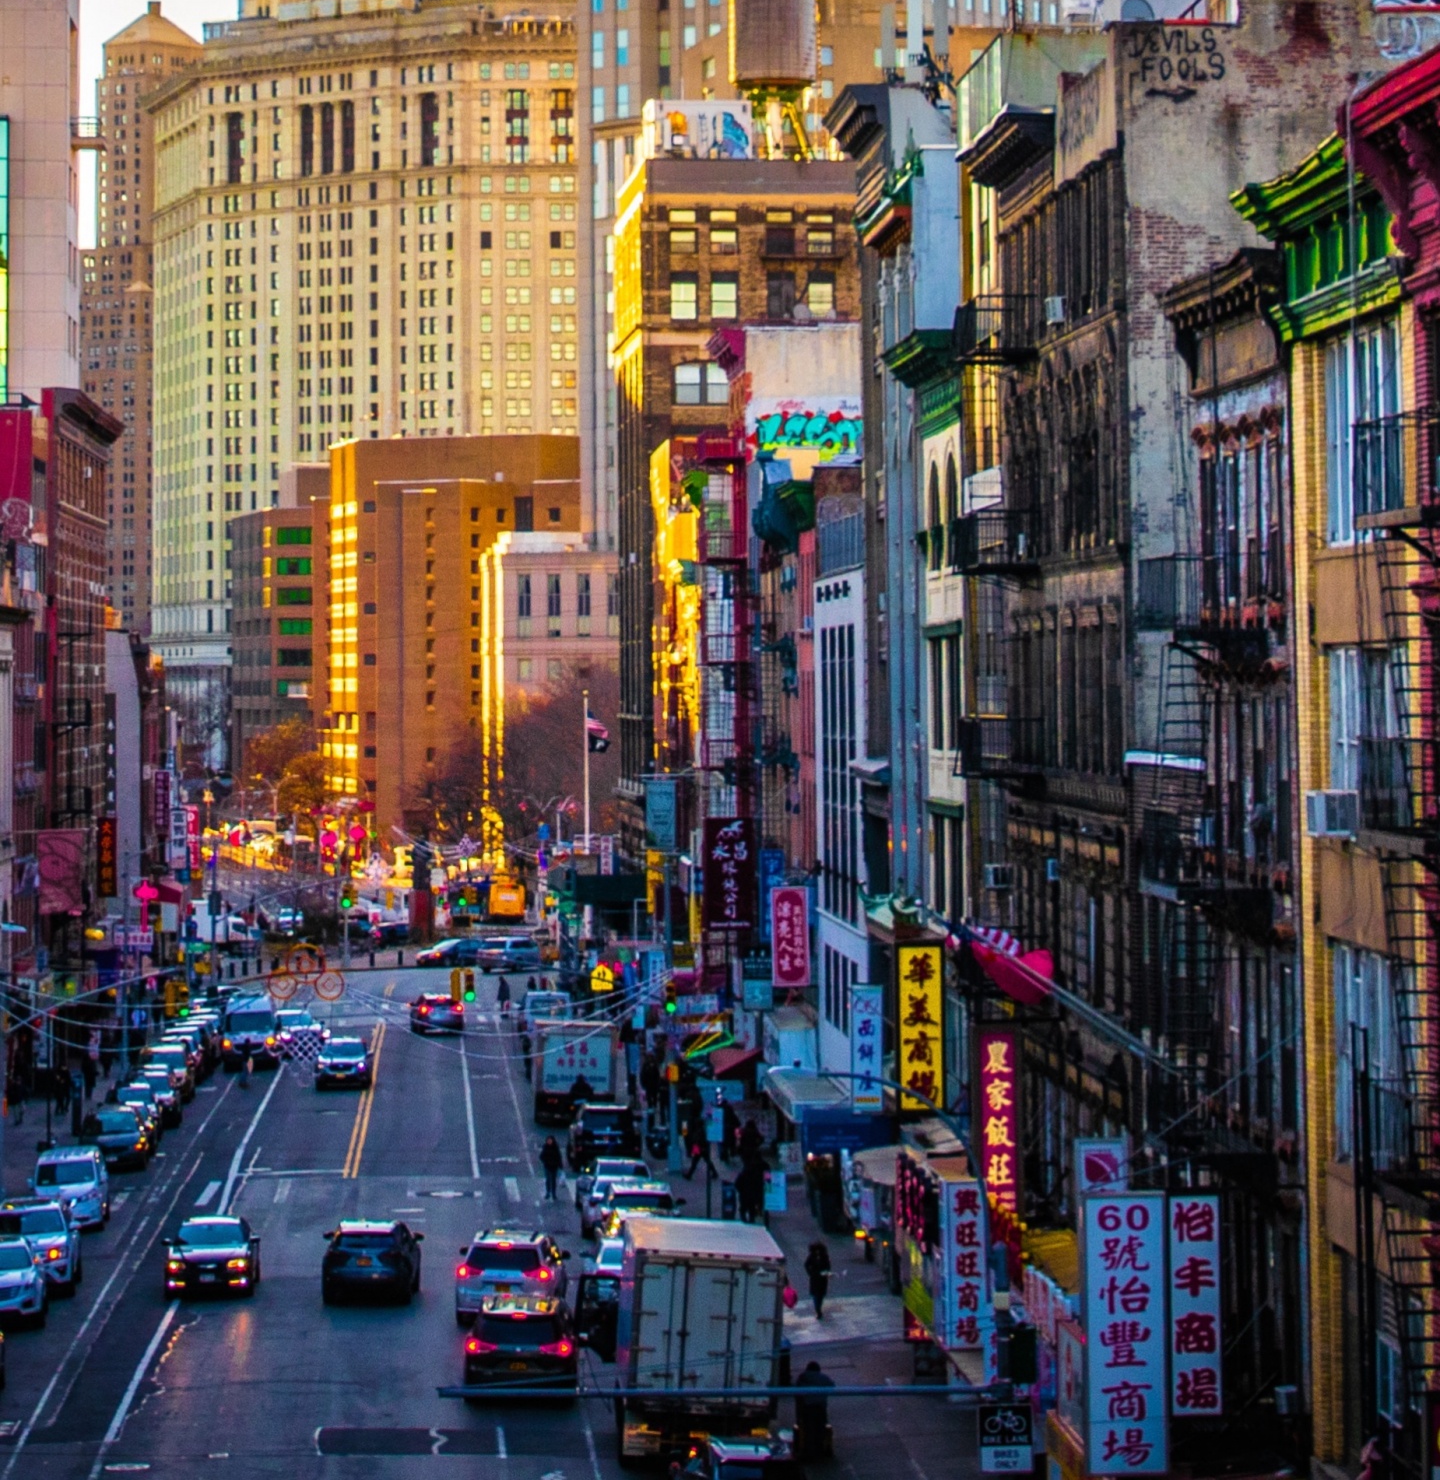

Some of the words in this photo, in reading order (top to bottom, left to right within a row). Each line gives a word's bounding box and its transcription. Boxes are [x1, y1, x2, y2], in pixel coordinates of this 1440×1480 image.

[1141, 53, 1225, 81] FOOLS
[904, 953, 939, 1105] 華美商場
[954, 1189, 981, 1345] 興旺旺商場
[982, 1435, 1002, 1444] BIKE
[1005, 1435, 1029, 1444] LANE
[994, 1449, 1020, 1459] BIKES
[995, 1459, 1018, 1469] ONLY
